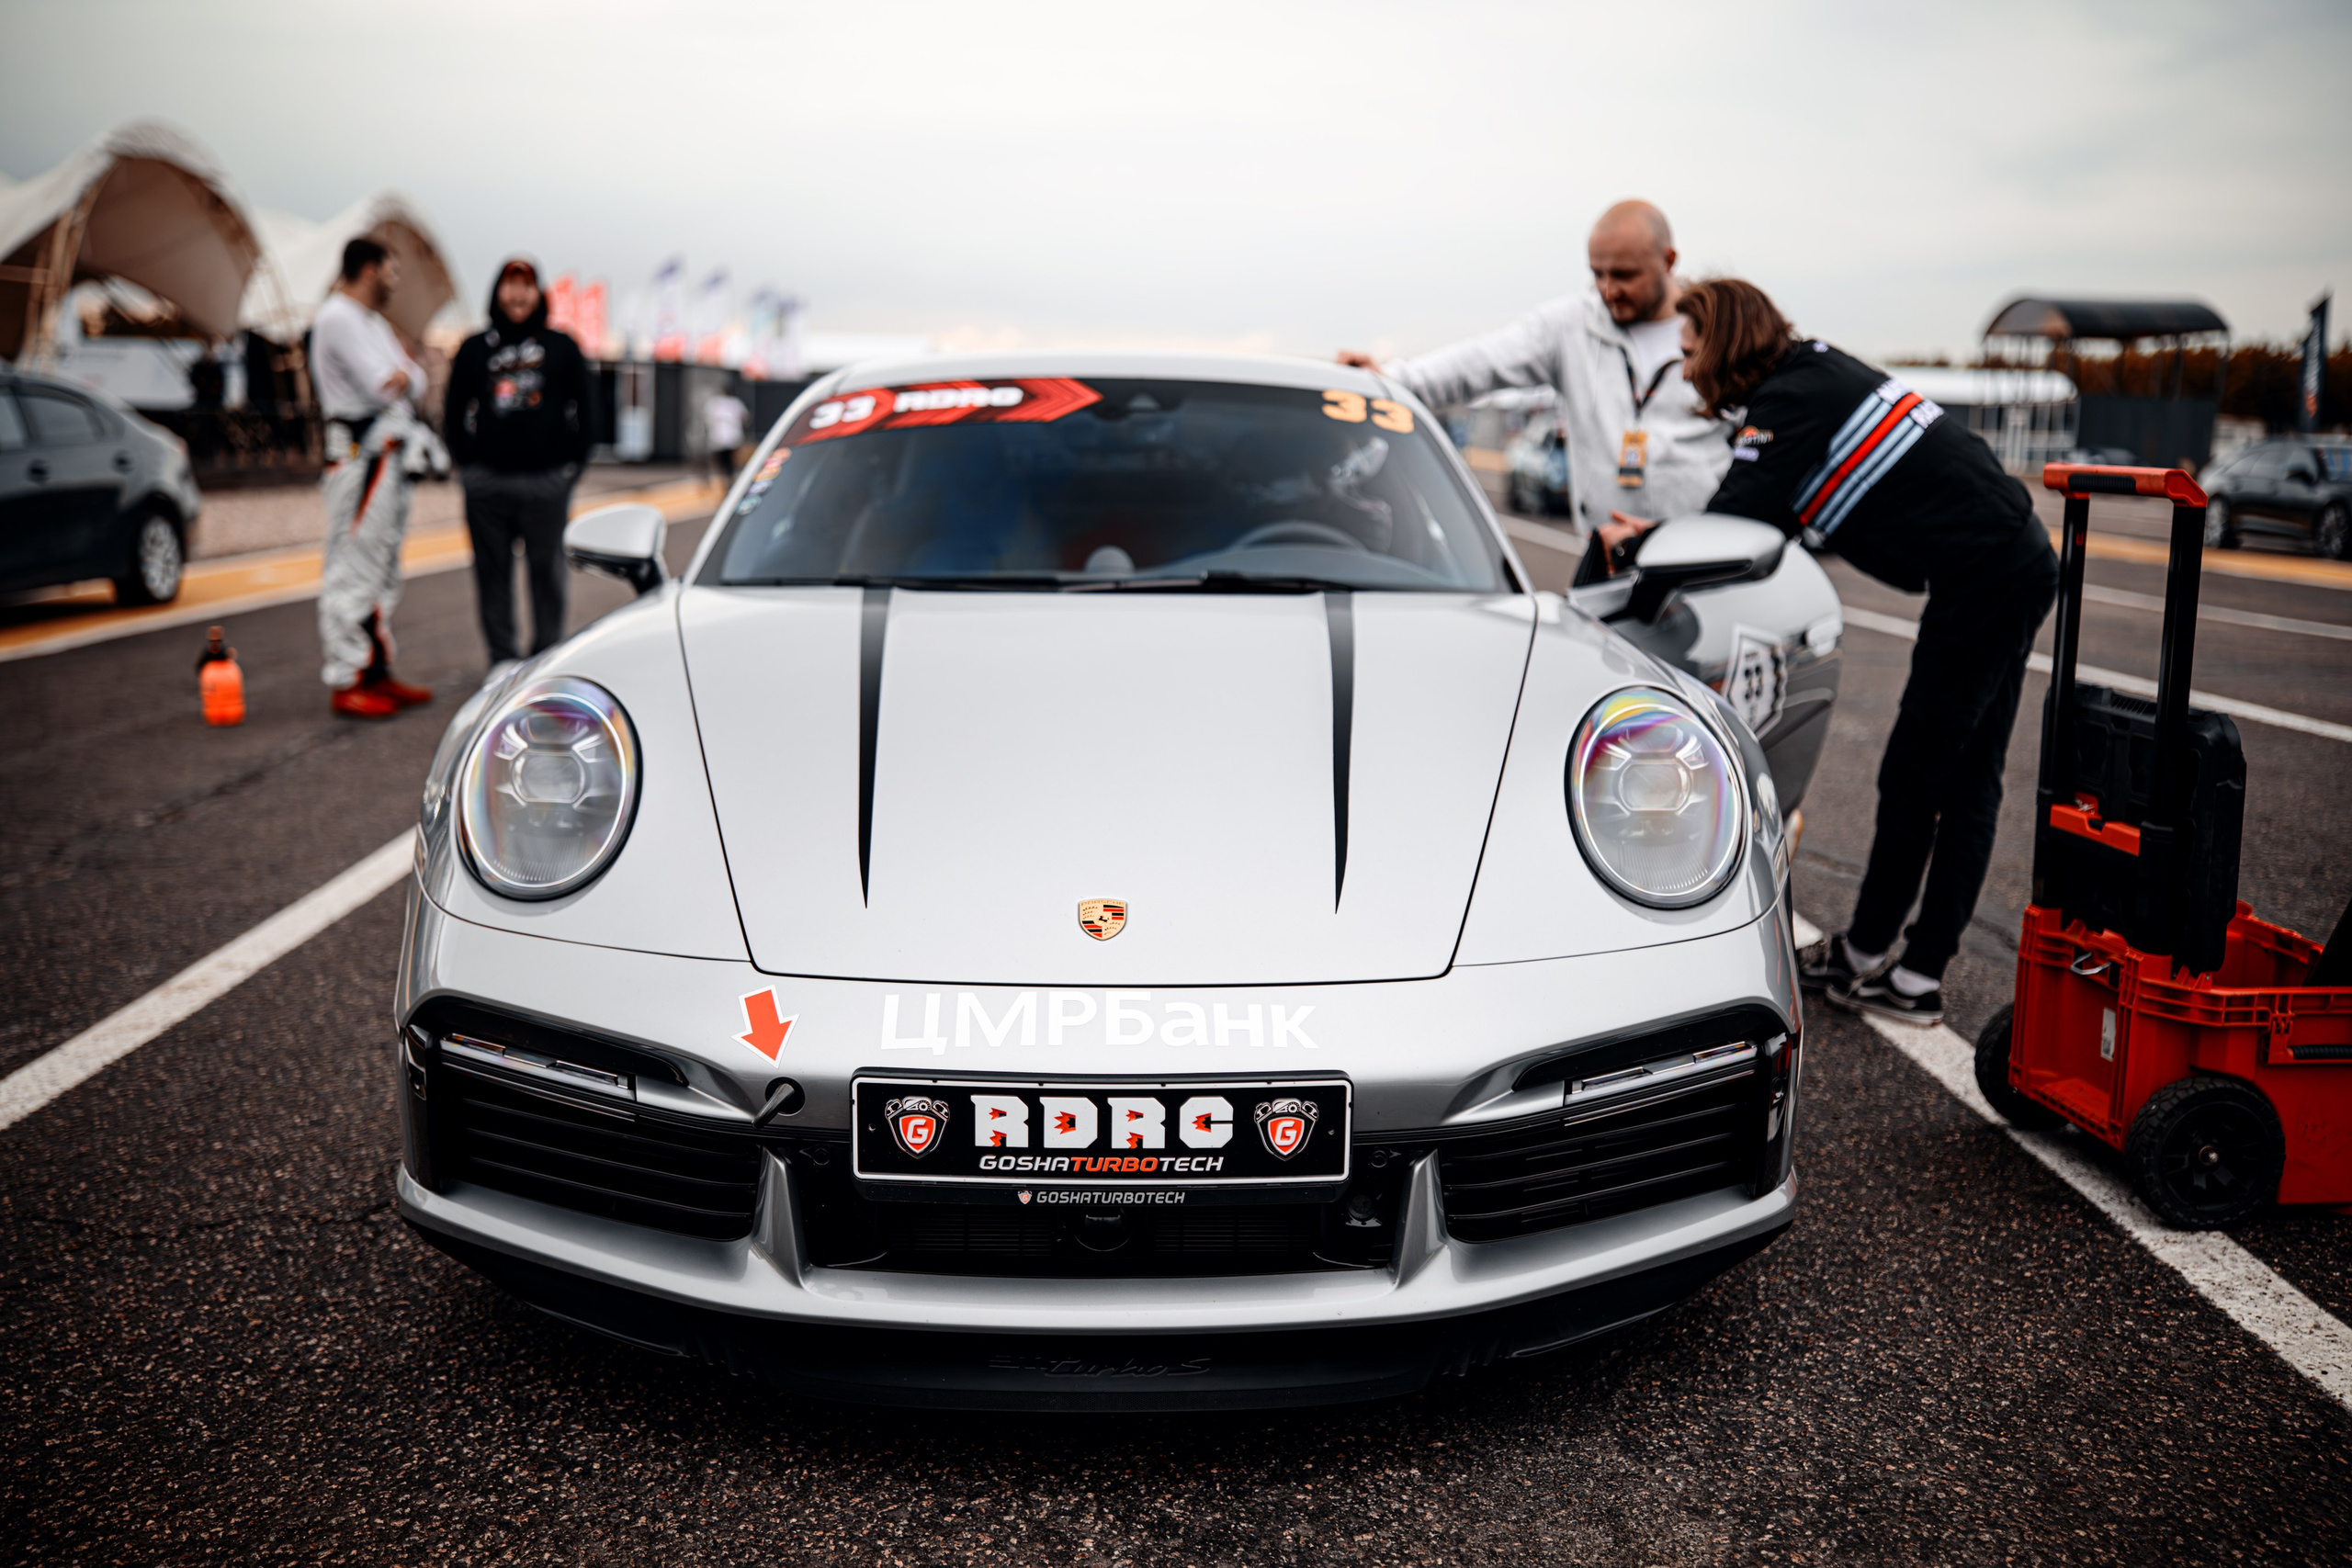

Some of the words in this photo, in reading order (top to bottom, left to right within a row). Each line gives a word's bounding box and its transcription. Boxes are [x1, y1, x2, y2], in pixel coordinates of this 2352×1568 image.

[808, 395, 876, 429] 33
[1321, 389, 1414, 434] 33
[880, 990, 1320, 1055] ЦМРБанк
[970, 1094, 1234, 1149] RDRC
[978, 1155, 1224, 1172] GOSHATURBOTECH
[1036, 1191, 1186, 1204] GOSHATURBOTECH
